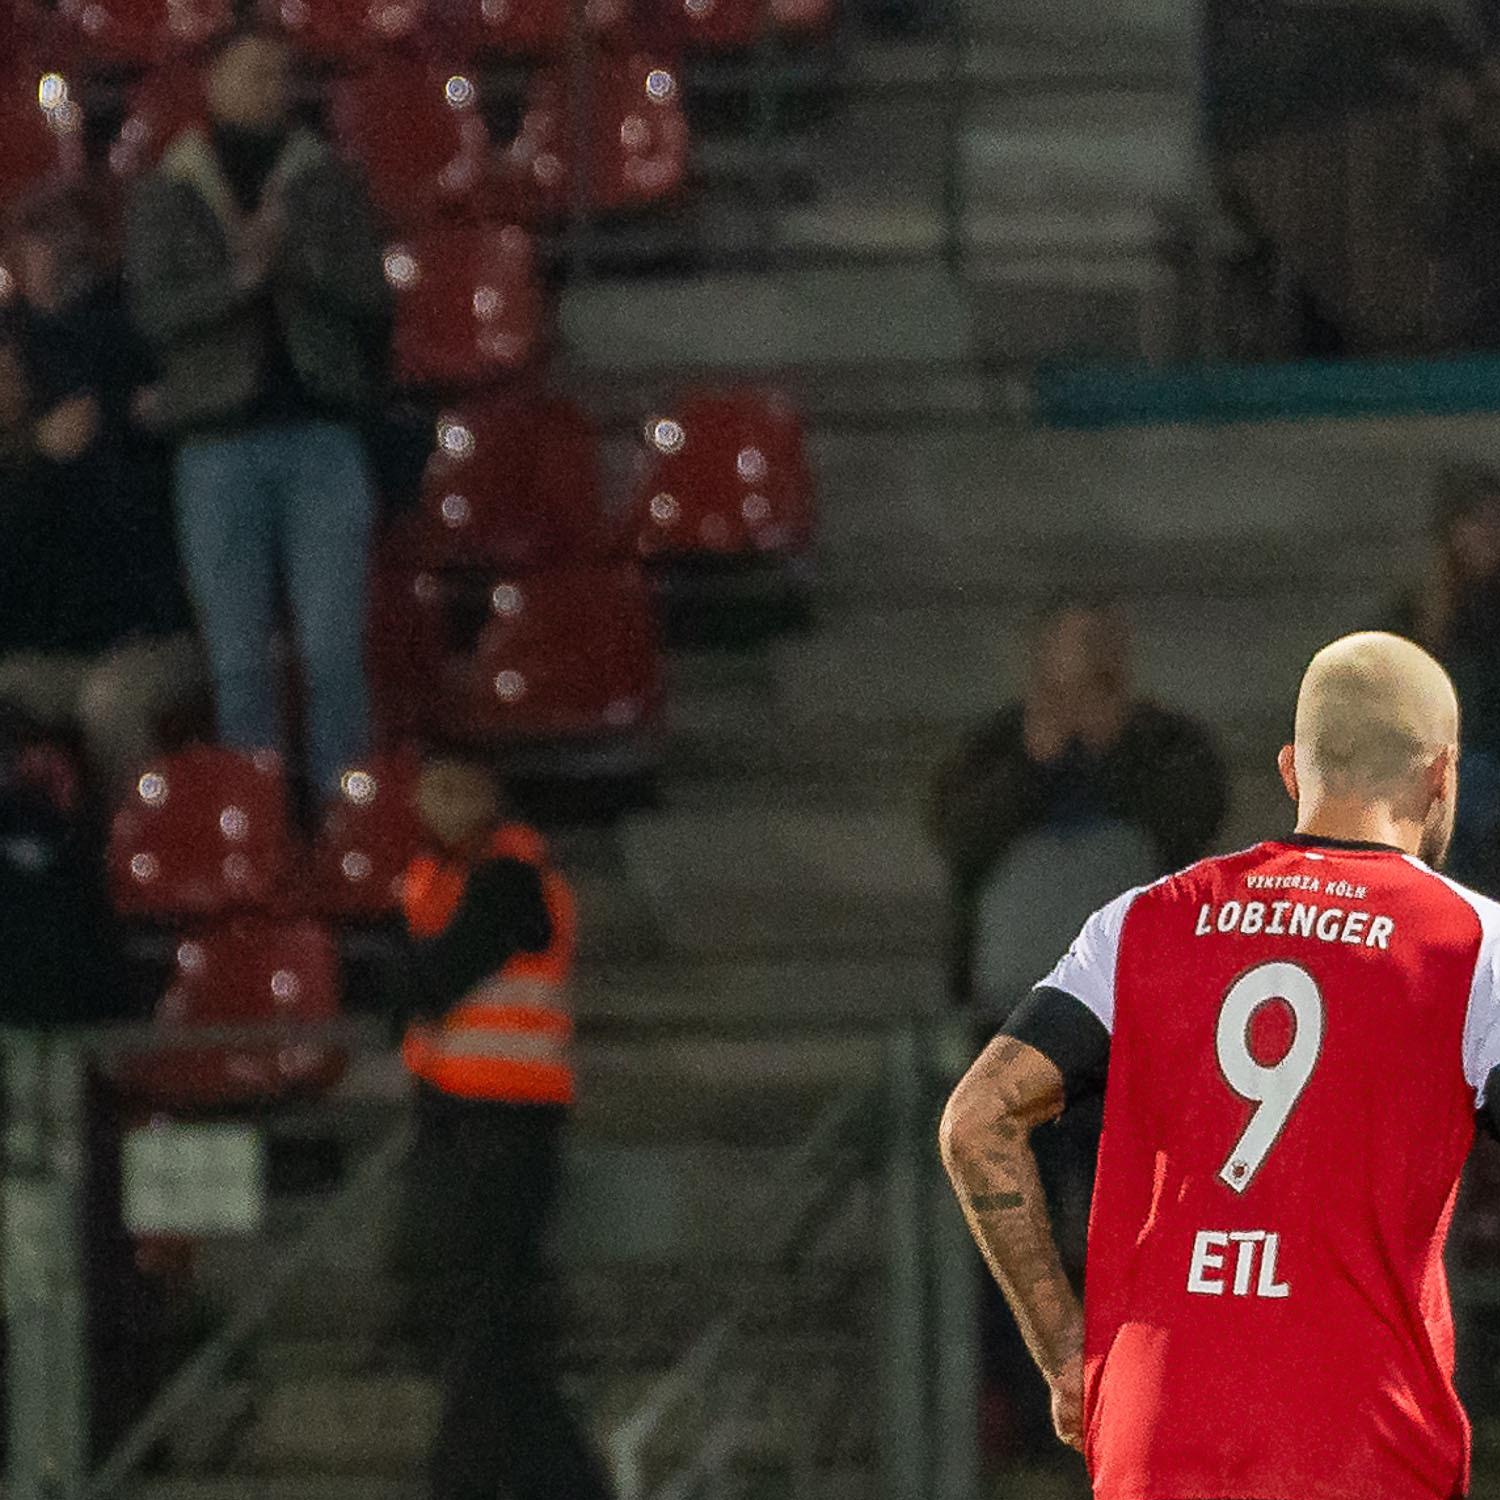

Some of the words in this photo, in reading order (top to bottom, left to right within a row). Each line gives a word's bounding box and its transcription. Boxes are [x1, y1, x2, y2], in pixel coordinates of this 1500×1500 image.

[1246, 875, 1321, 892] VIKTORIA
[1325, 879, 1368, 899] KÖLN
[1194, 900, 1395, 949] LOBINGER
[1215, 960, 1325, 1194] 9
[1186, 1230, 1290, 1299] ETL
